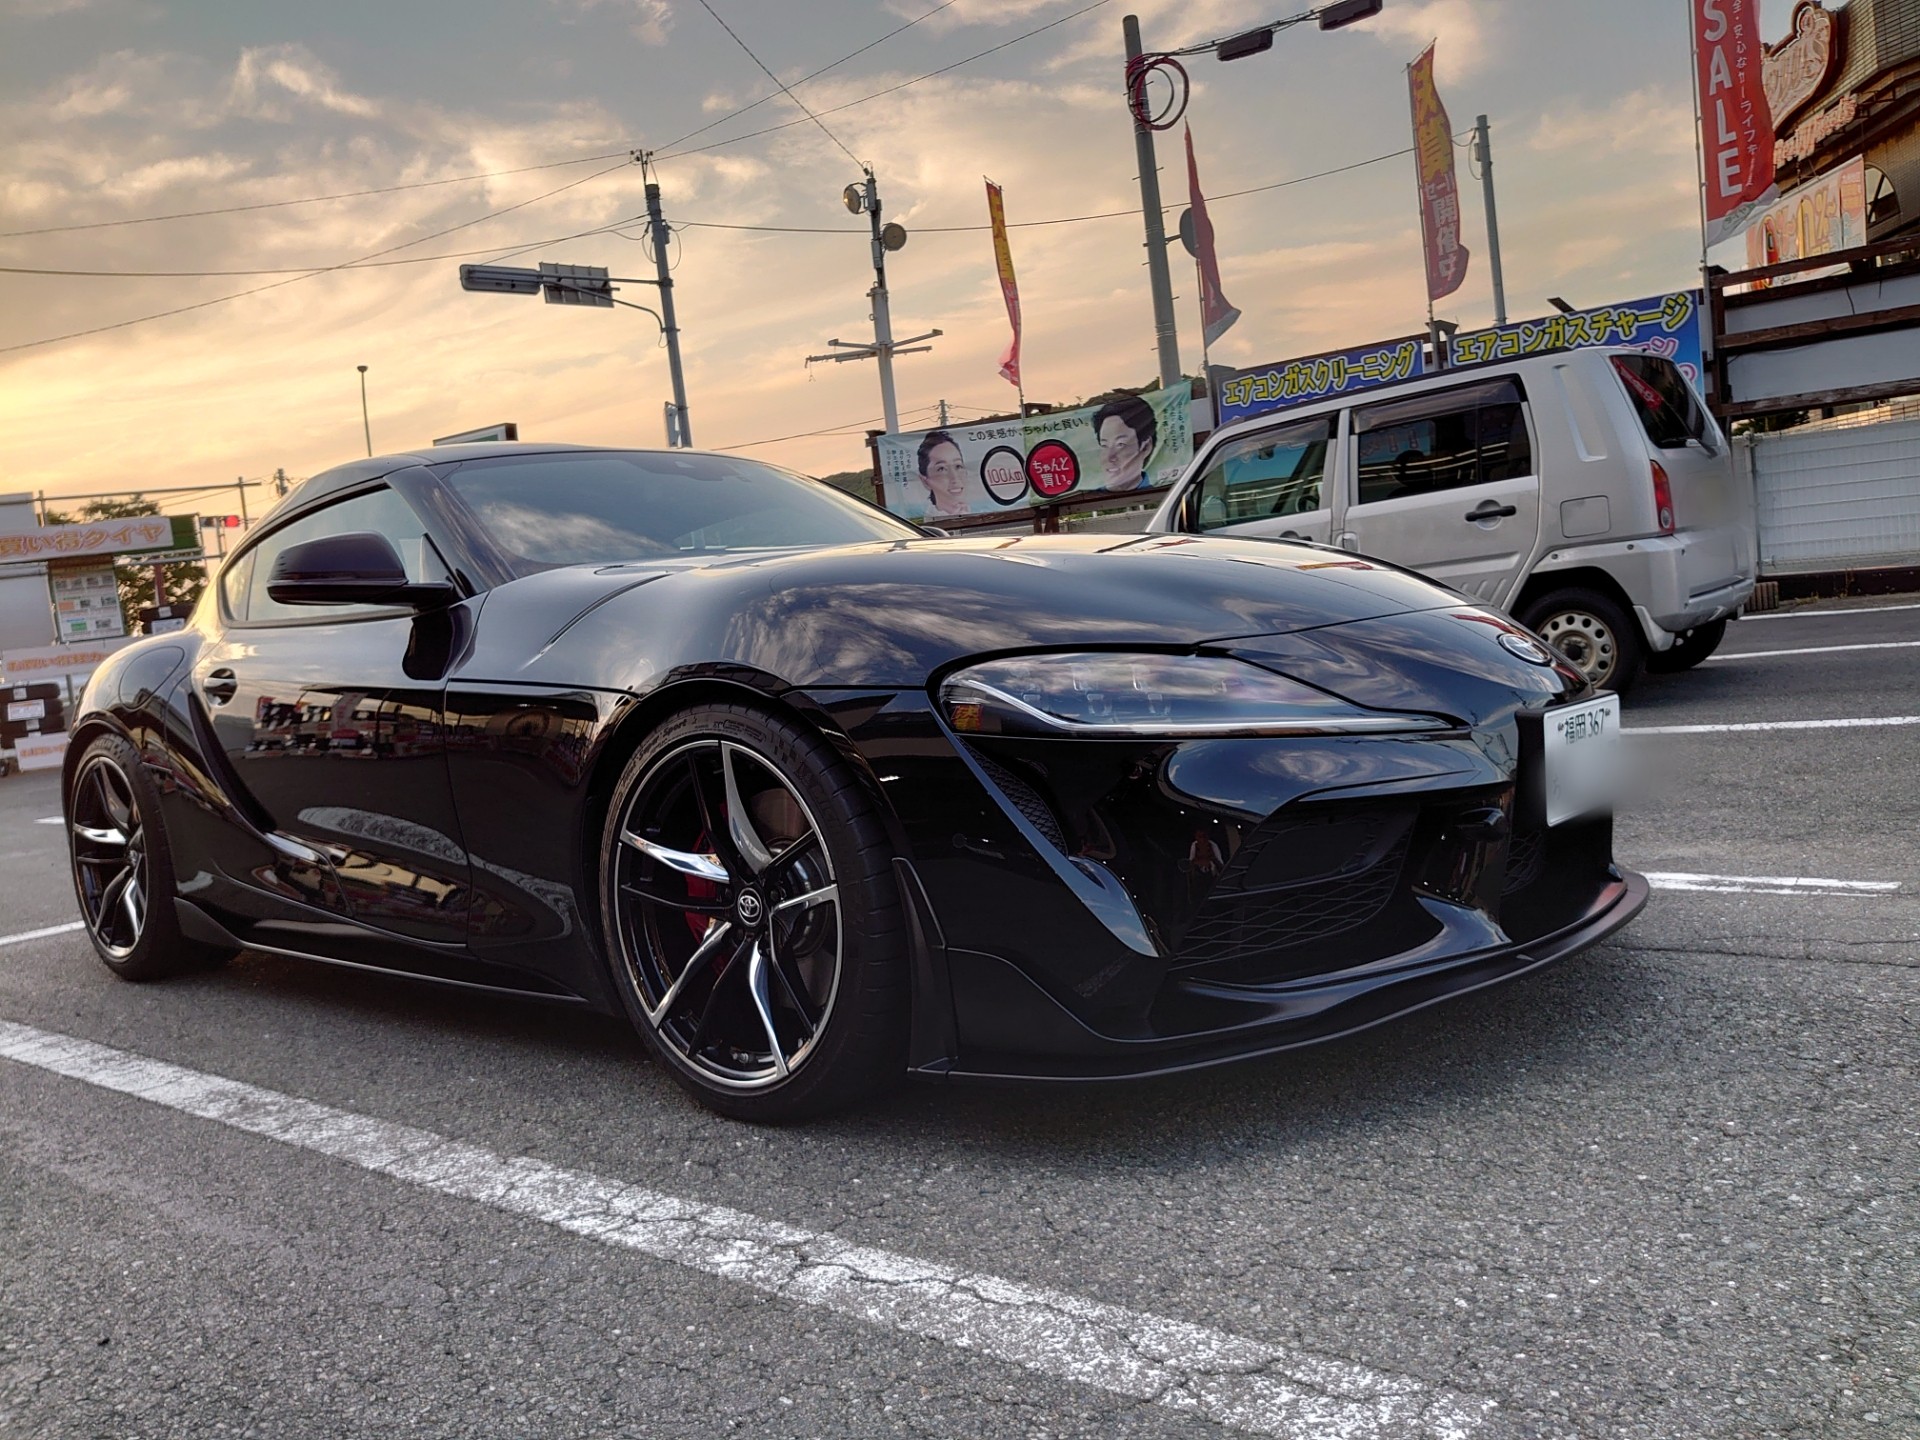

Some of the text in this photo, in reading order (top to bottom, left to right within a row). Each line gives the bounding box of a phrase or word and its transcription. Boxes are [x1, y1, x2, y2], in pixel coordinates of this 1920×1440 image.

[1703, 0, 1743, 197] SALE
[1457, 293, 1690, 363] エアコンガスチャージ
[1225, 344, 1415, 404] エアコンガスクリーニング
[987, 467, 1024, 484] 100人の
[1032, 457, 1069, 474] ちゃんと
[1041, 473, 1072, 488] 買い。
[1565, 707, 1605, 745] 福岡 367
